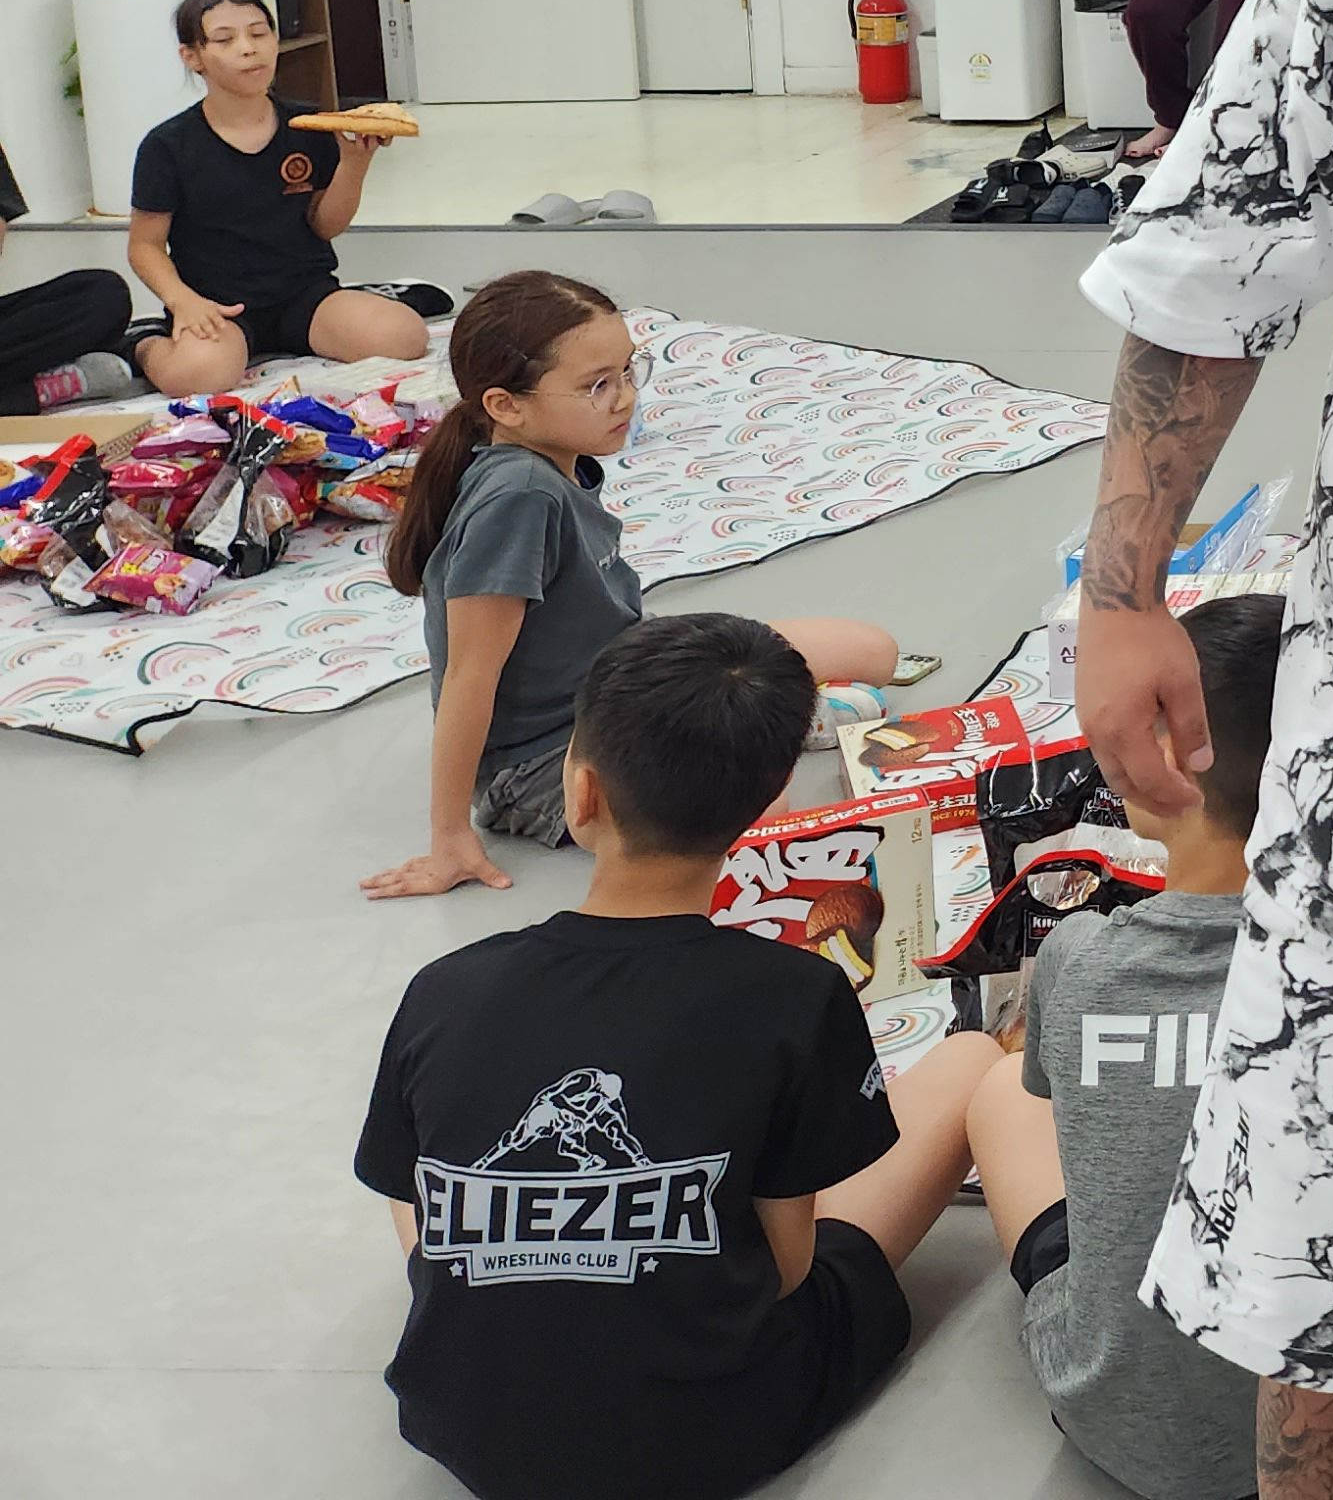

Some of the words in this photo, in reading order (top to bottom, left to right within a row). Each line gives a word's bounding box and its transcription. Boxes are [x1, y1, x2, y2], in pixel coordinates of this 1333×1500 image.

[1080, 1013, 1209, 1087] FIL
[423, 1169, 711, 1246] ELIEZER
[482, 1253, 572, 1270] WRESTLING
[576, 1252, 619, 1268] CLUB
